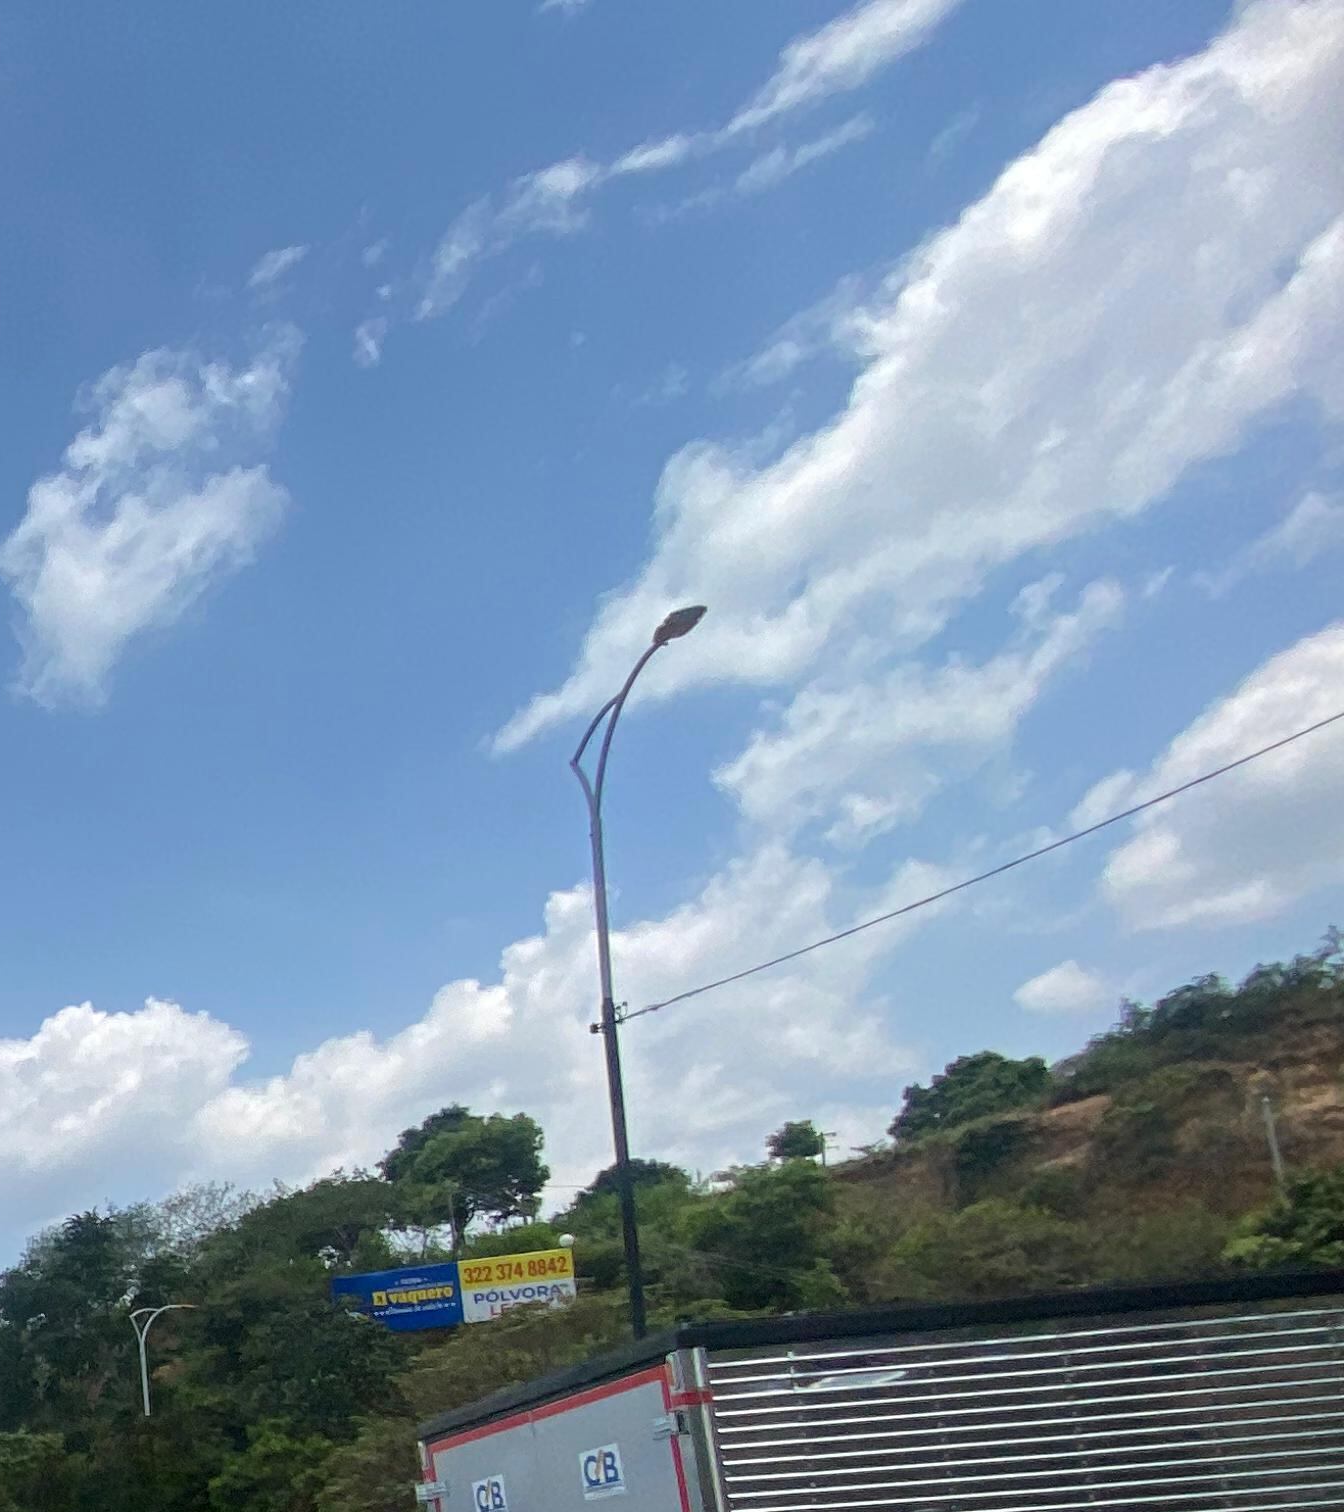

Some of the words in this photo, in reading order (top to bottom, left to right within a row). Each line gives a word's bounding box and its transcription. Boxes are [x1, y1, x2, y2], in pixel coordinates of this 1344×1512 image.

[463, 1266, 492, 1284] 322
[496, 1262, 523, 1281] 374
[528, 1256, 569, 1277] 8842
